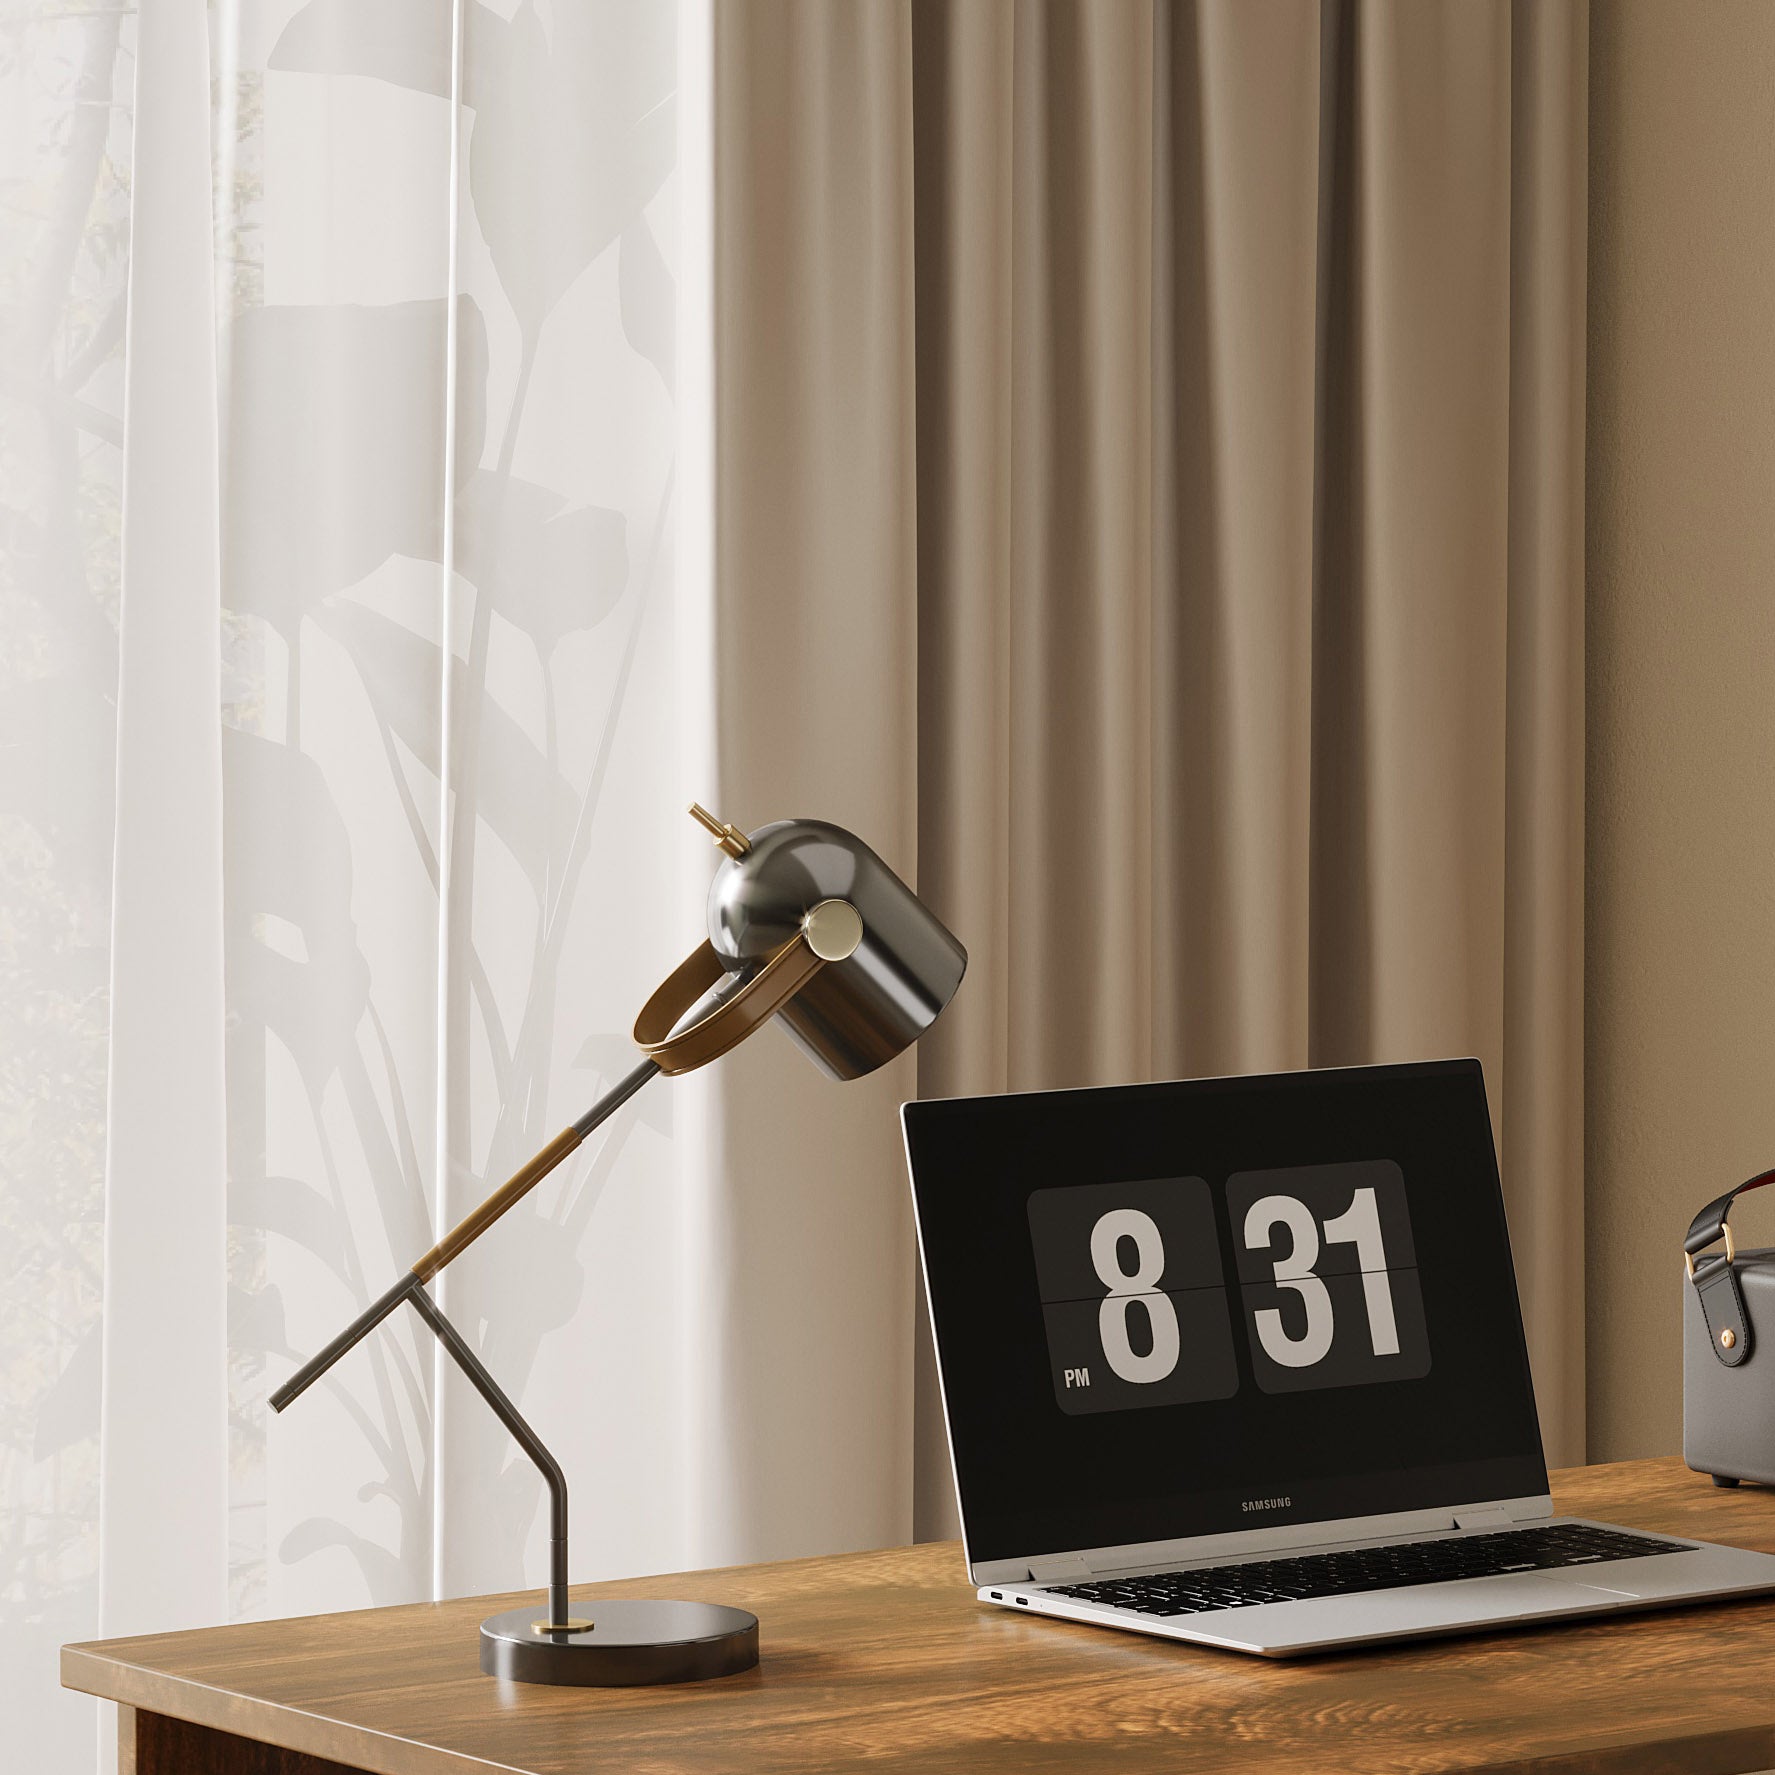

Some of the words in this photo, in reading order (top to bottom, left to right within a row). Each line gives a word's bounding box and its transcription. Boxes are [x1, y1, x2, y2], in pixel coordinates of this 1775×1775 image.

[1090, 1208, 1180, 1384] 8
[1243, 1187, 1400, 1368] 31
[1064, 1368, 1090, 1388] PM
[1241, 1497, 1292, 1512] SAMSUNG
